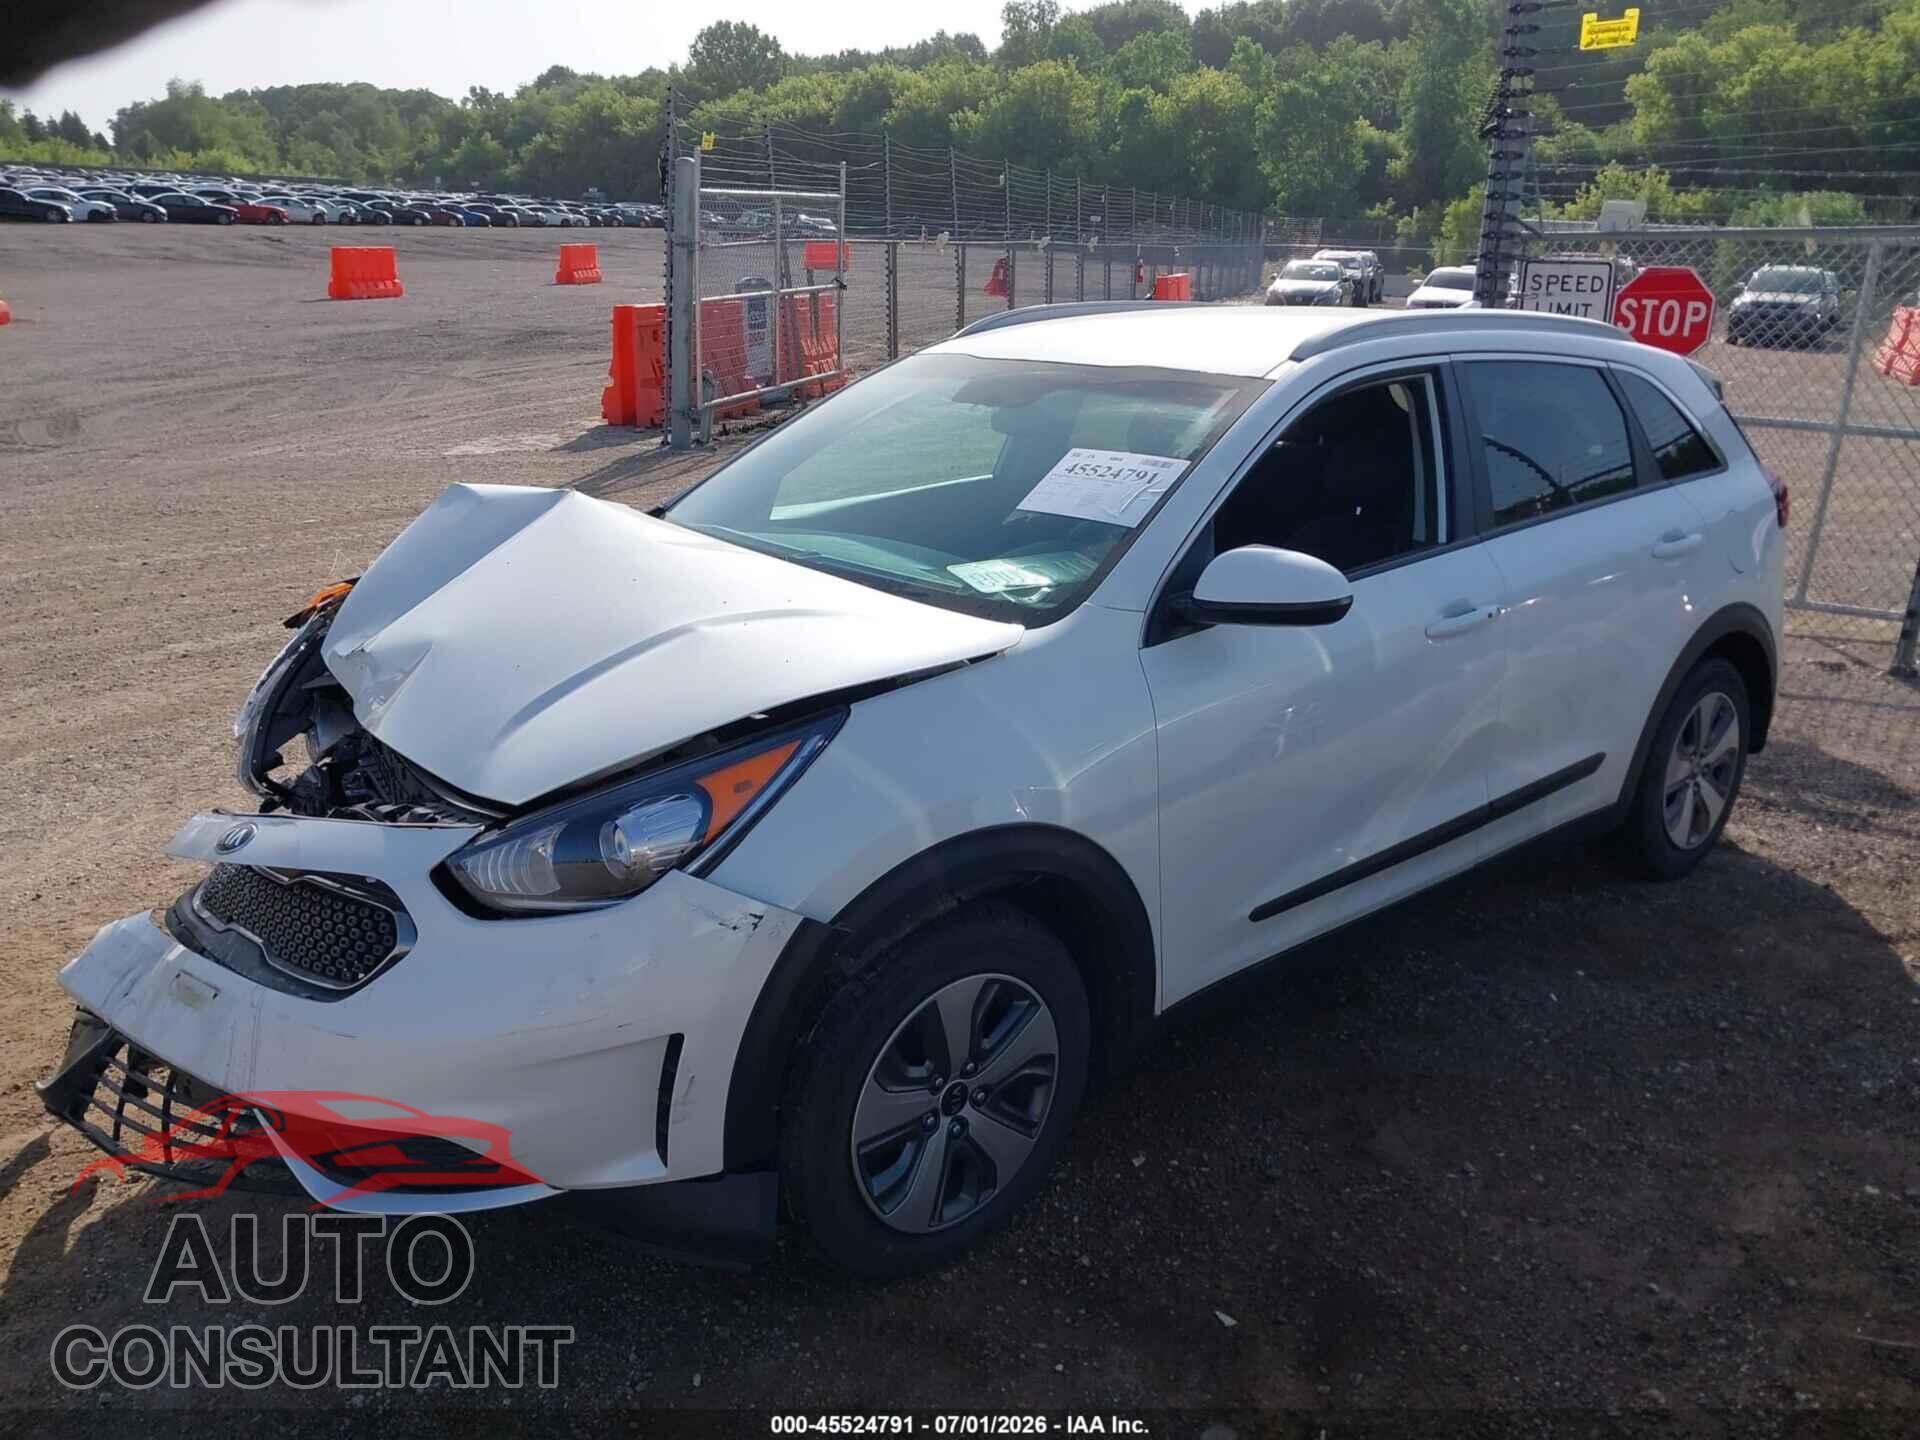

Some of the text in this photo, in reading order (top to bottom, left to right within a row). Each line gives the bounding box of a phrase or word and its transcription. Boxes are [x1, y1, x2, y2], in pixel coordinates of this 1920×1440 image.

[1530, 274, 1604, 293] SPEED
[1617, 298, 1708, 337] STOP
[1064, 463, 1159, 484] 45524791
